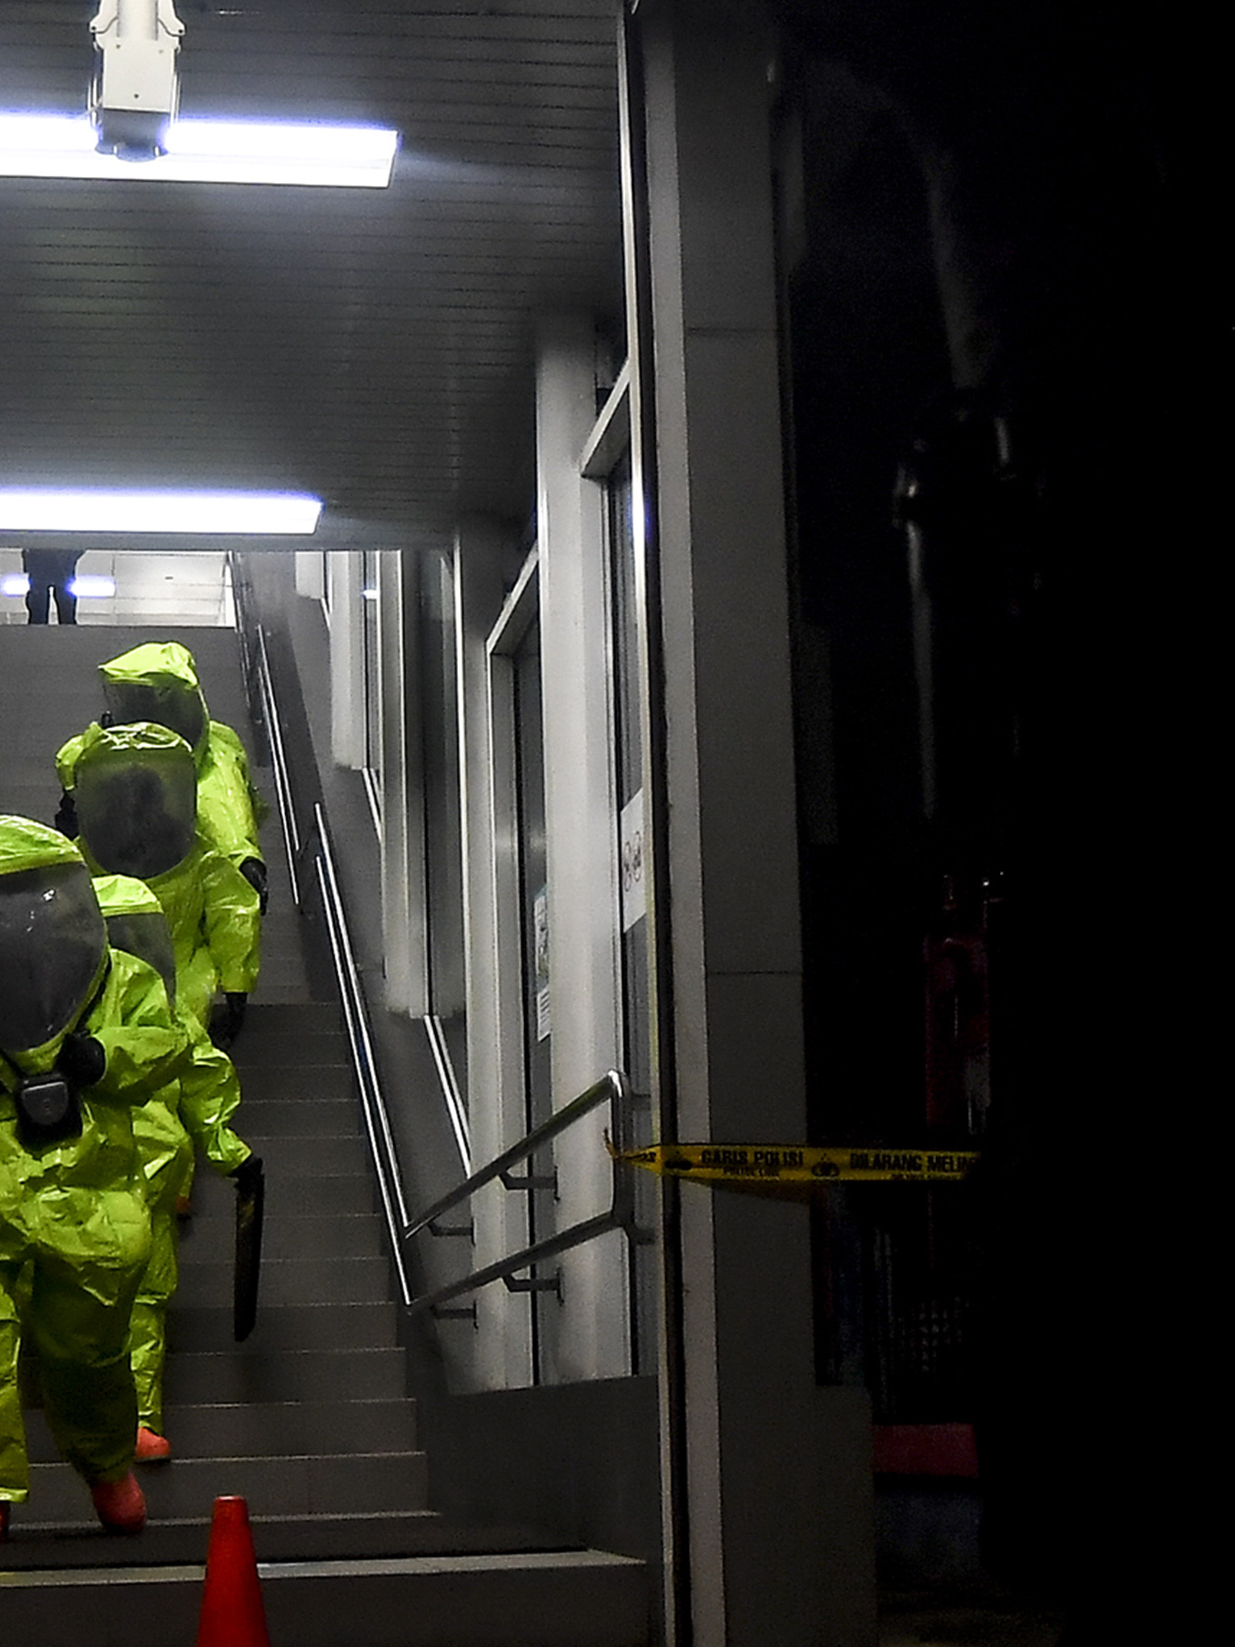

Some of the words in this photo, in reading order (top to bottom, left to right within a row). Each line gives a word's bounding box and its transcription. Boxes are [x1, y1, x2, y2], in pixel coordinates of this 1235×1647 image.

[701, 1150, 748, 1166] GARIS
[754, 1151, 803, 1167] POLISI
[850, 1152, 922, 1172] DILARANG
